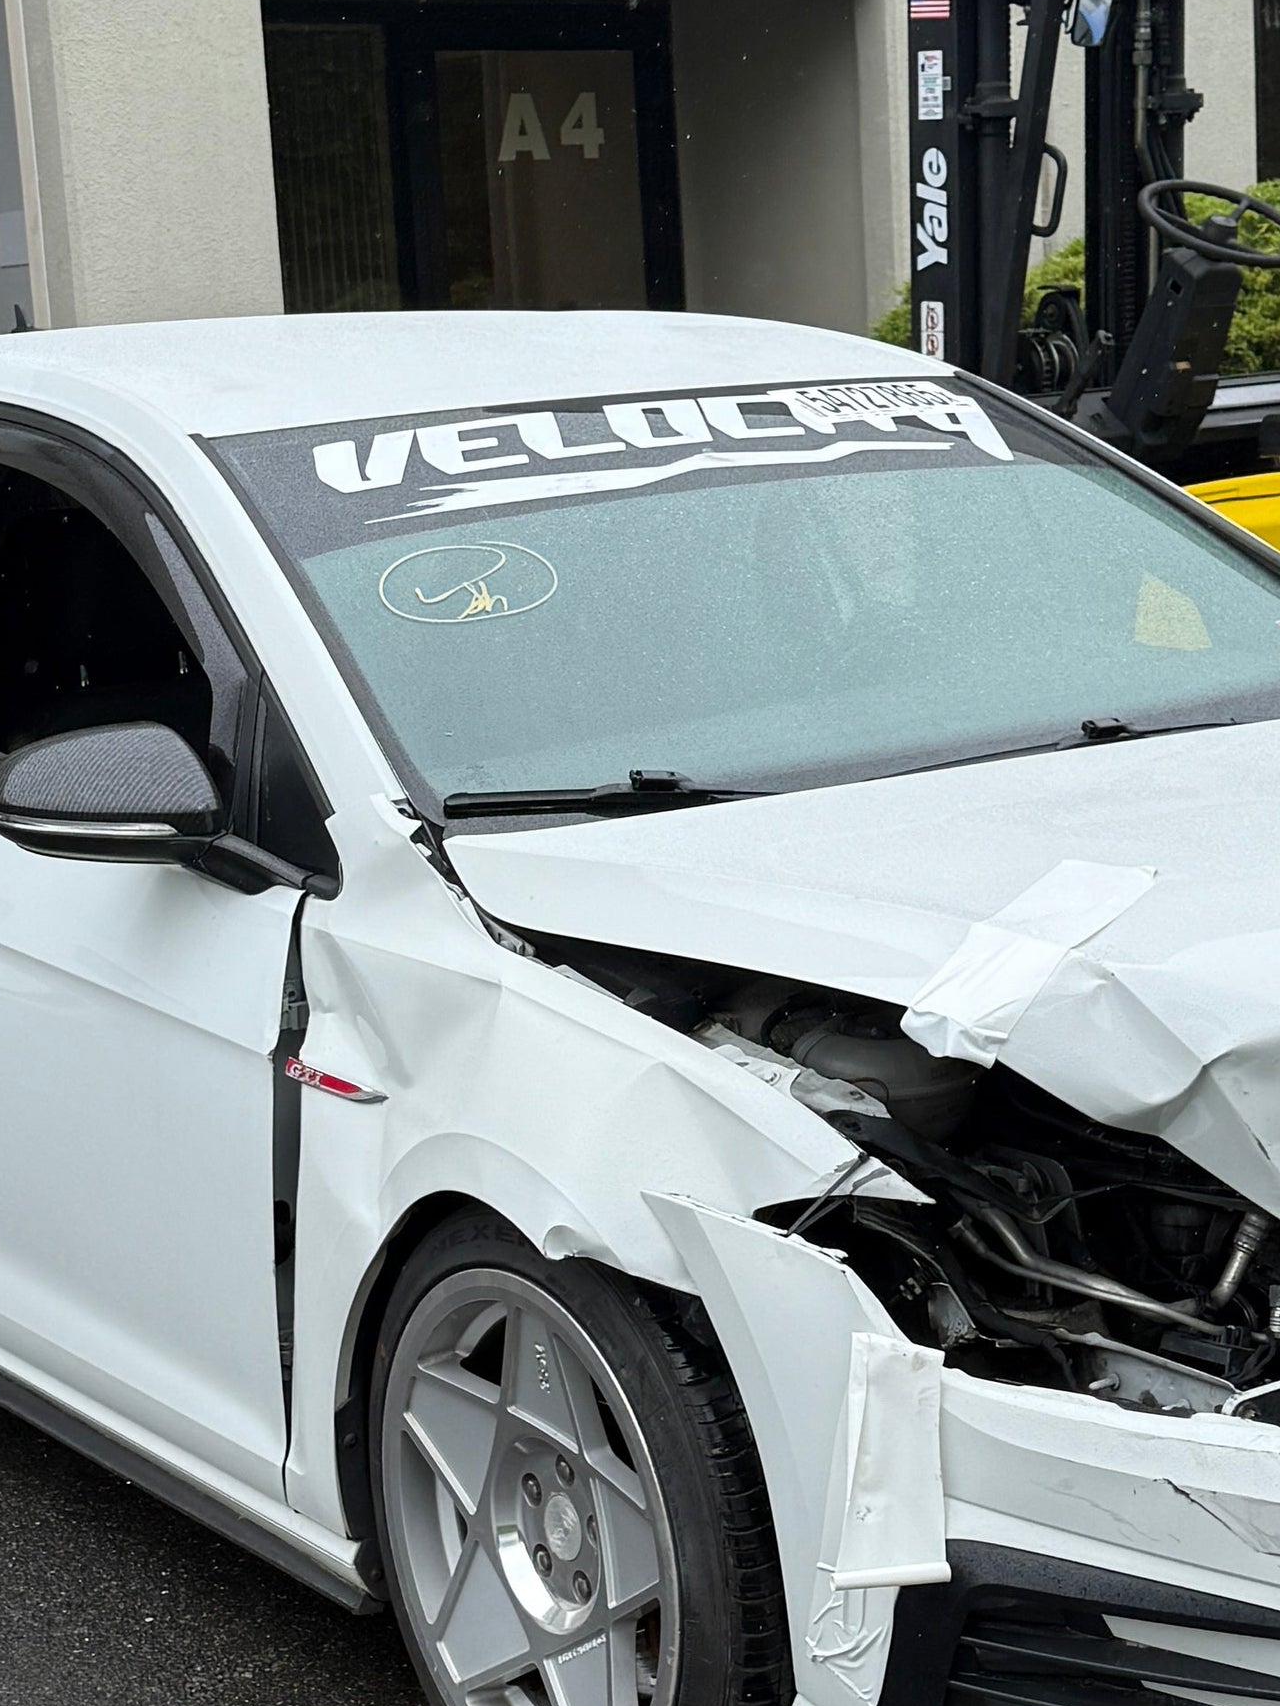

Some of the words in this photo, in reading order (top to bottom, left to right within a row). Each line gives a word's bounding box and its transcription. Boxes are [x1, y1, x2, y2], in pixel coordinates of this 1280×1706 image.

[497, 91, 606, 162] A4
[915, 147, 949, 272] Yale
[289, 1062, 324, 1088] GTI
